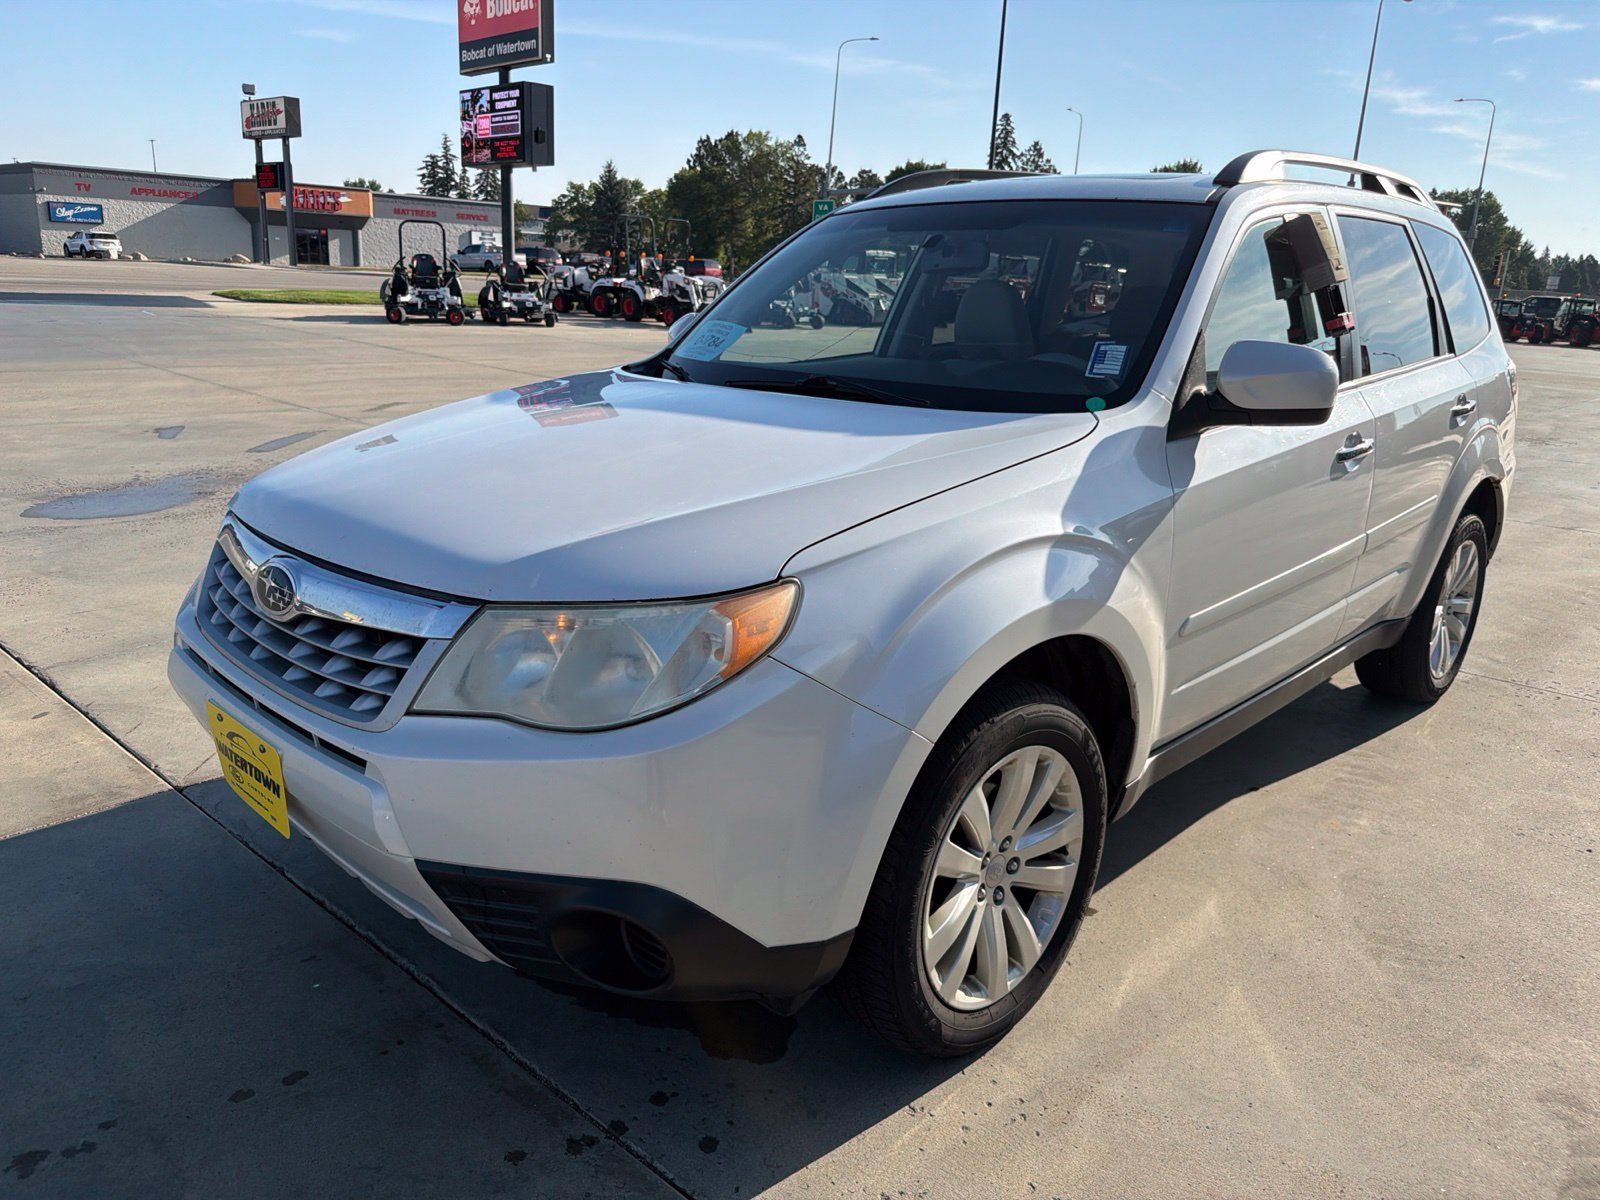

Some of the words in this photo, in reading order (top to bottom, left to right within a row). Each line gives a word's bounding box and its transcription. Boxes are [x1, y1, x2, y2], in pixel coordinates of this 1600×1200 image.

[461, 46, 487, 62] Bobcat
[487, 44, 496, 57] of
[496, 39, 537, 56] Watertown
[75, 182, 91, 192] TV
[130, 187, 199, 199] APPLIANCES
[393, 207, 437, 218] MATTRESS
[456, 212, 489, 222] SERVICE
[215, 736, 281, 799] WATERTOWN
